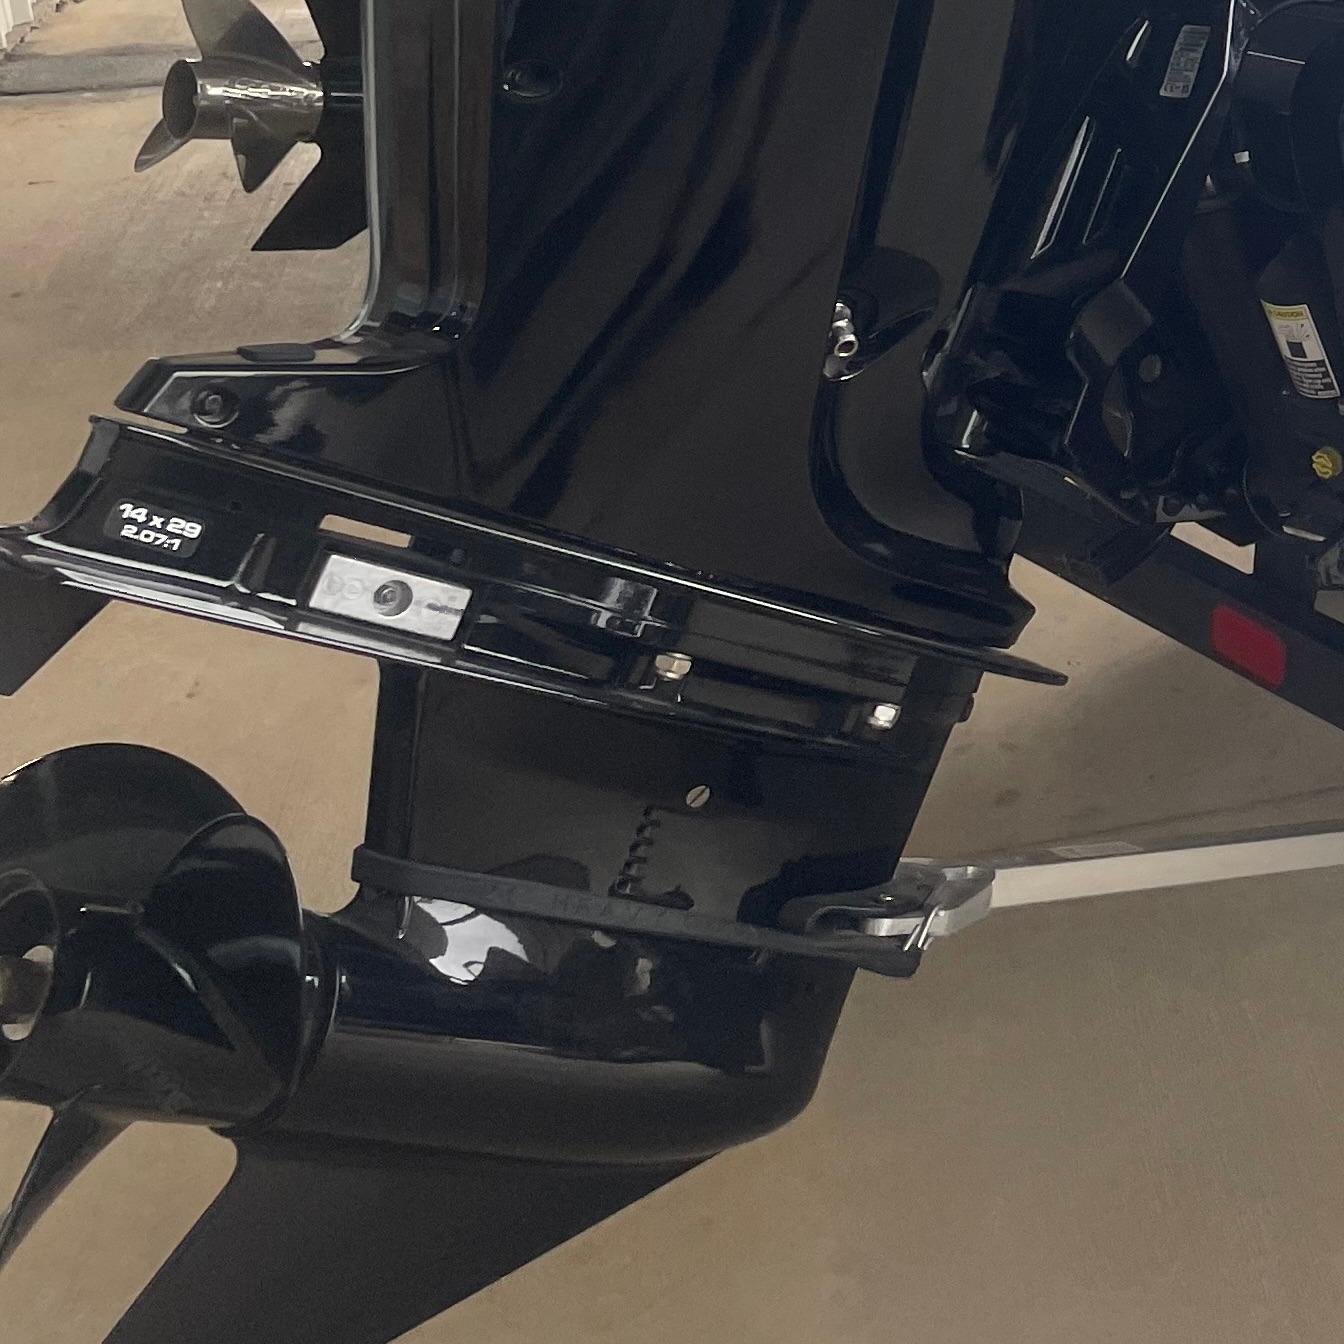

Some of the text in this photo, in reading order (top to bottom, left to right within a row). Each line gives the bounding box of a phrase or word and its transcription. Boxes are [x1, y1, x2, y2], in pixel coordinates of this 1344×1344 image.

[120, 503, 202, 539] 14 x 29
[120, 524, 181, 551] 2.07:1
